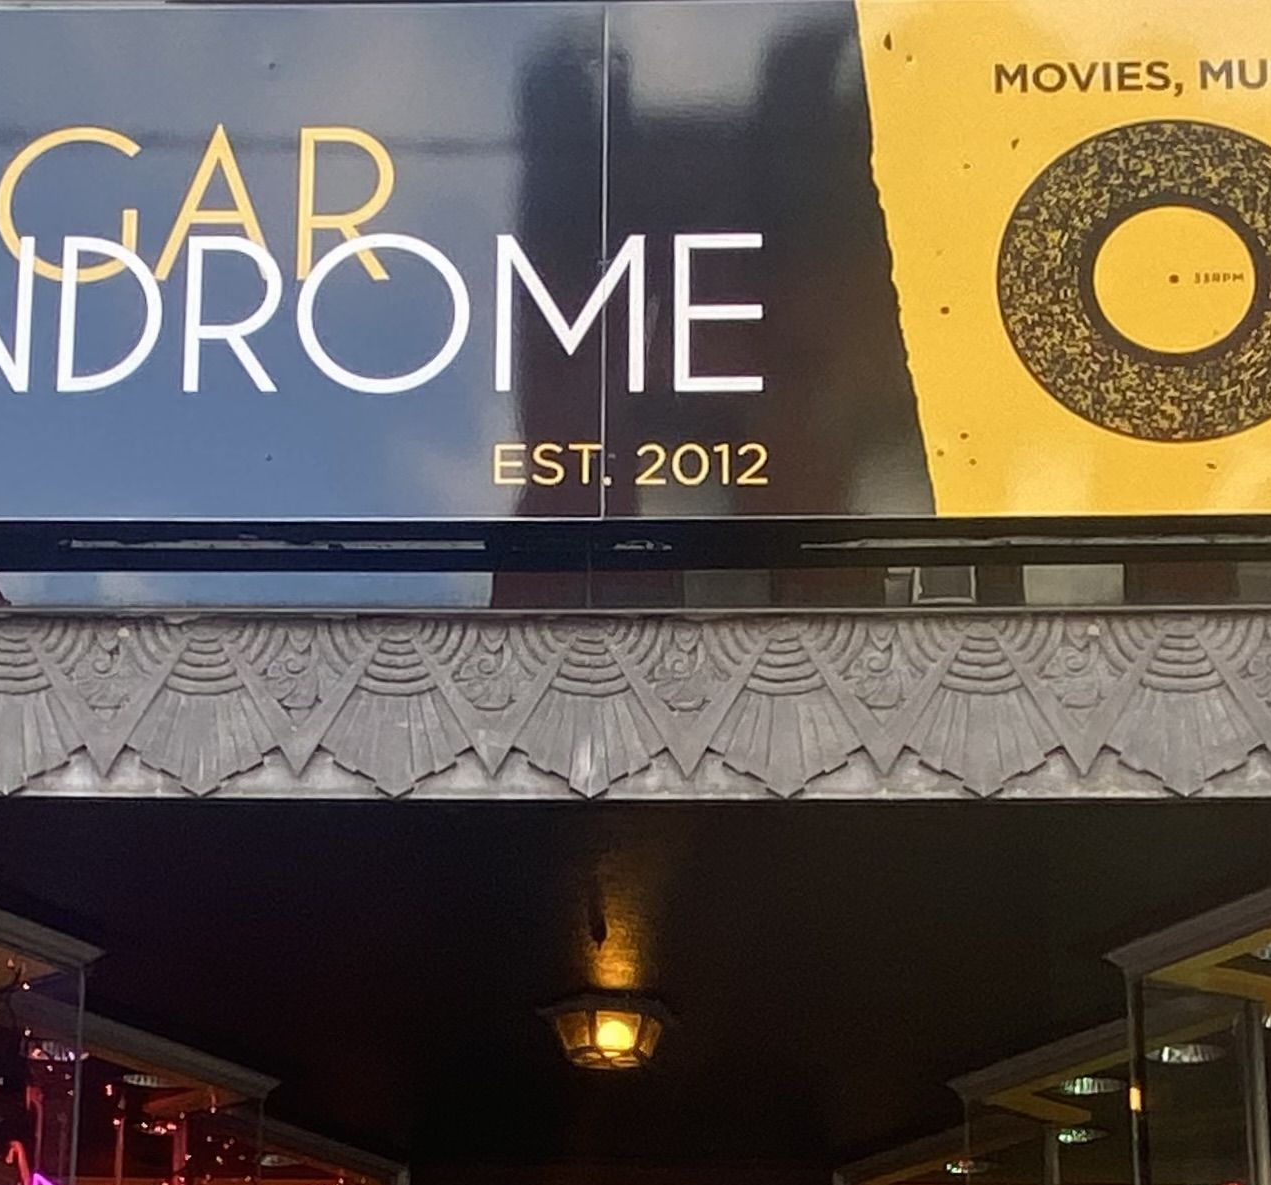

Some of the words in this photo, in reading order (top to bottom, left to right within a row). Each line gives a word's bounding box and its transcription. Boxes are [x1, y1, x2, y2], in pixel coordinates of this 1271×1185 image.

[994, 60, 1184, 96] MOVIES,
[492, 442, 613, 486] EST.
[637, 441, 770, 486] 2012
